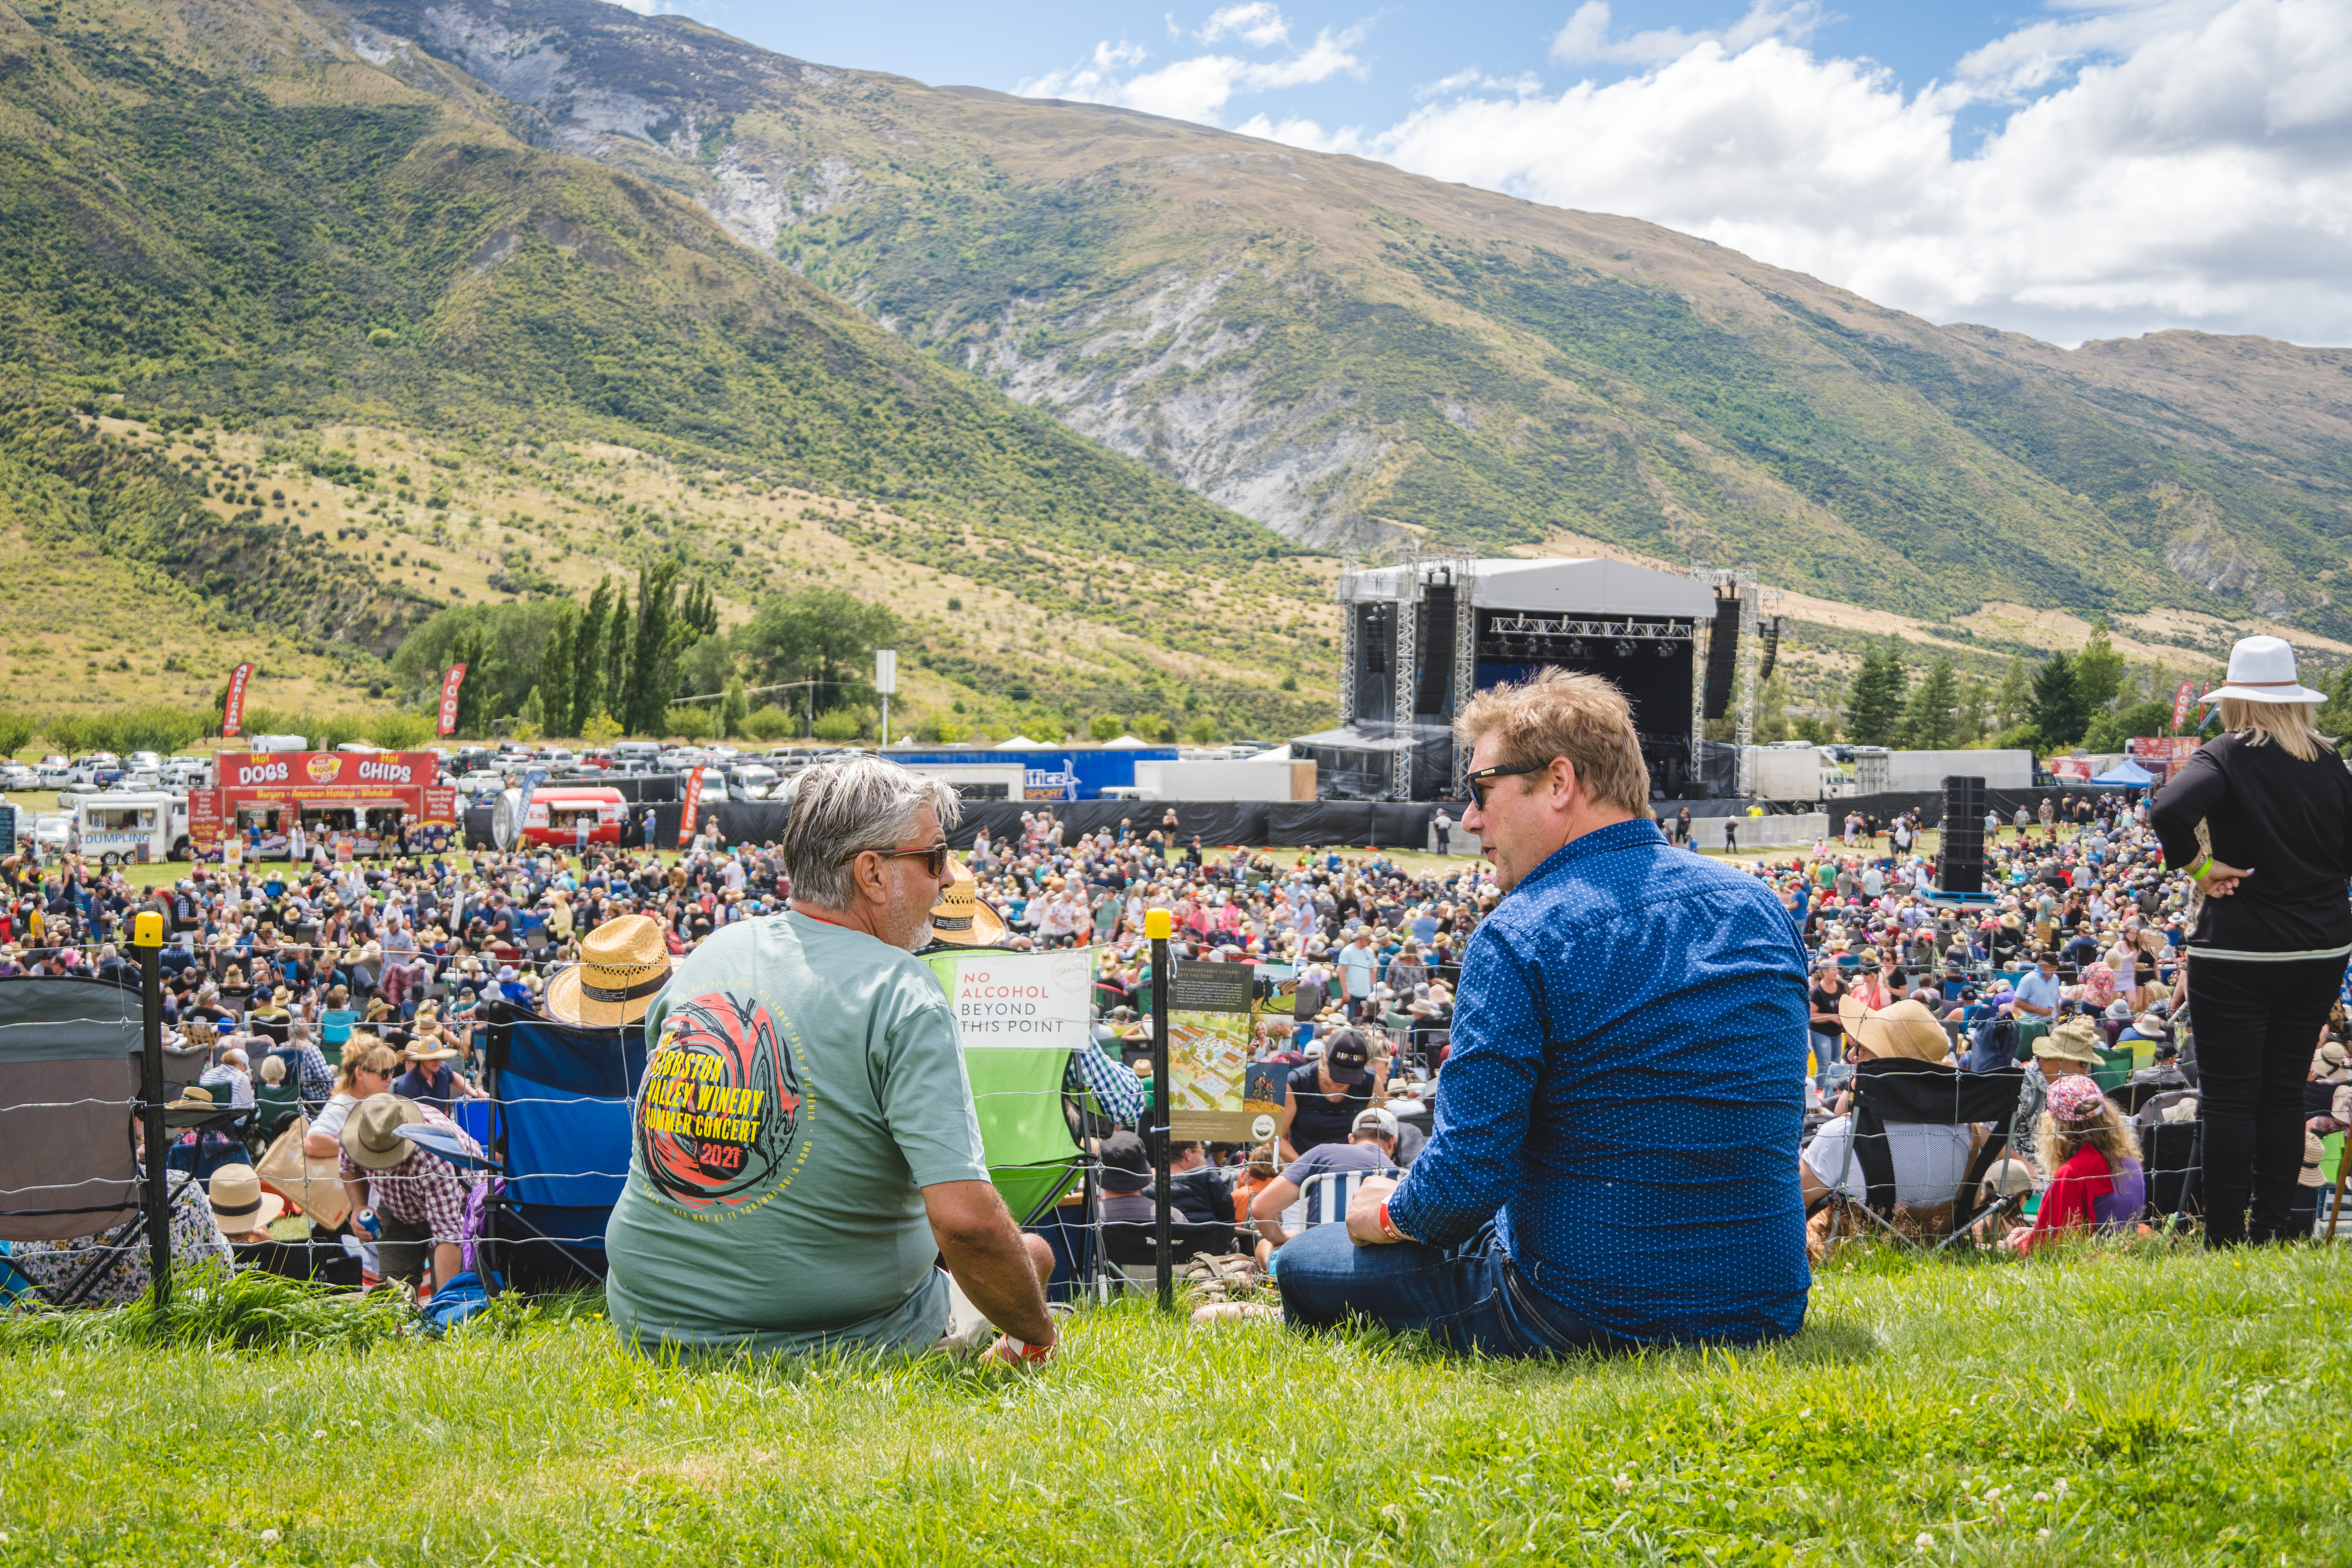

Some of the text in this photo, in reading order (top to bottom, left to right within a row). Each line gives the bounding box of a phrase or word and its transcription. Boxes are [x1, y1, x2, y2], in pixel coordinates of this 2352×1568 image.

[229, 665, 247, 723] AMERICAN
[442, 670, 460, 726] FOOD
[2175, 685, 2189, 724] FOOD
[251, 753, 270, 764] Hot
[314, 764, 334, 773] FOOD
[381, 754, 399, 763] Hot
[239, 762, 289, 785] DOGS
[359, 761, 411, 783] CHIPS
[258, 790, 285, 799] Burgers
[292, 789, 324, 798] American
[326, 789, 355, 798] Hotdogs
[86, 833, 150, 844] DUMPLING
[964, 973, 990, 983] NO
[1055, 962, 1088, 980] Gibbston Valley
[961, 986, 1049, 998] ALCOHOL
[962, 1003, 1035, 1015] BEYOND
[672, 983, 705, 1004] TOKANGA
[735, 980, 751, 989] NOHO
[758, 989, 771, 1000] KIA
[771, 1001, 791, 1027] KAWEA
[804, 1077, 813, 1087] TE
[961, 1020, 1063, 1032] THIS POINT
[652, 1049, 726, 1082] GIBBSTON
[647, 1078, 765, 1116] VALLEY WINERY
[645, 1107, 760, 1143] SUMMER CONCERT
[700, 1143, 743, 1168] 2021
[674, 1208, 687, 1218] KIA
[693, 1214, 709, 1222] MAU
[727, 1211, 737, 1220] TE
[740, 1190, 779, 1215] TOKANGA
[779, 1175, 793, 1189] NUI
[797, 1141, 812, 1164] NOHO
